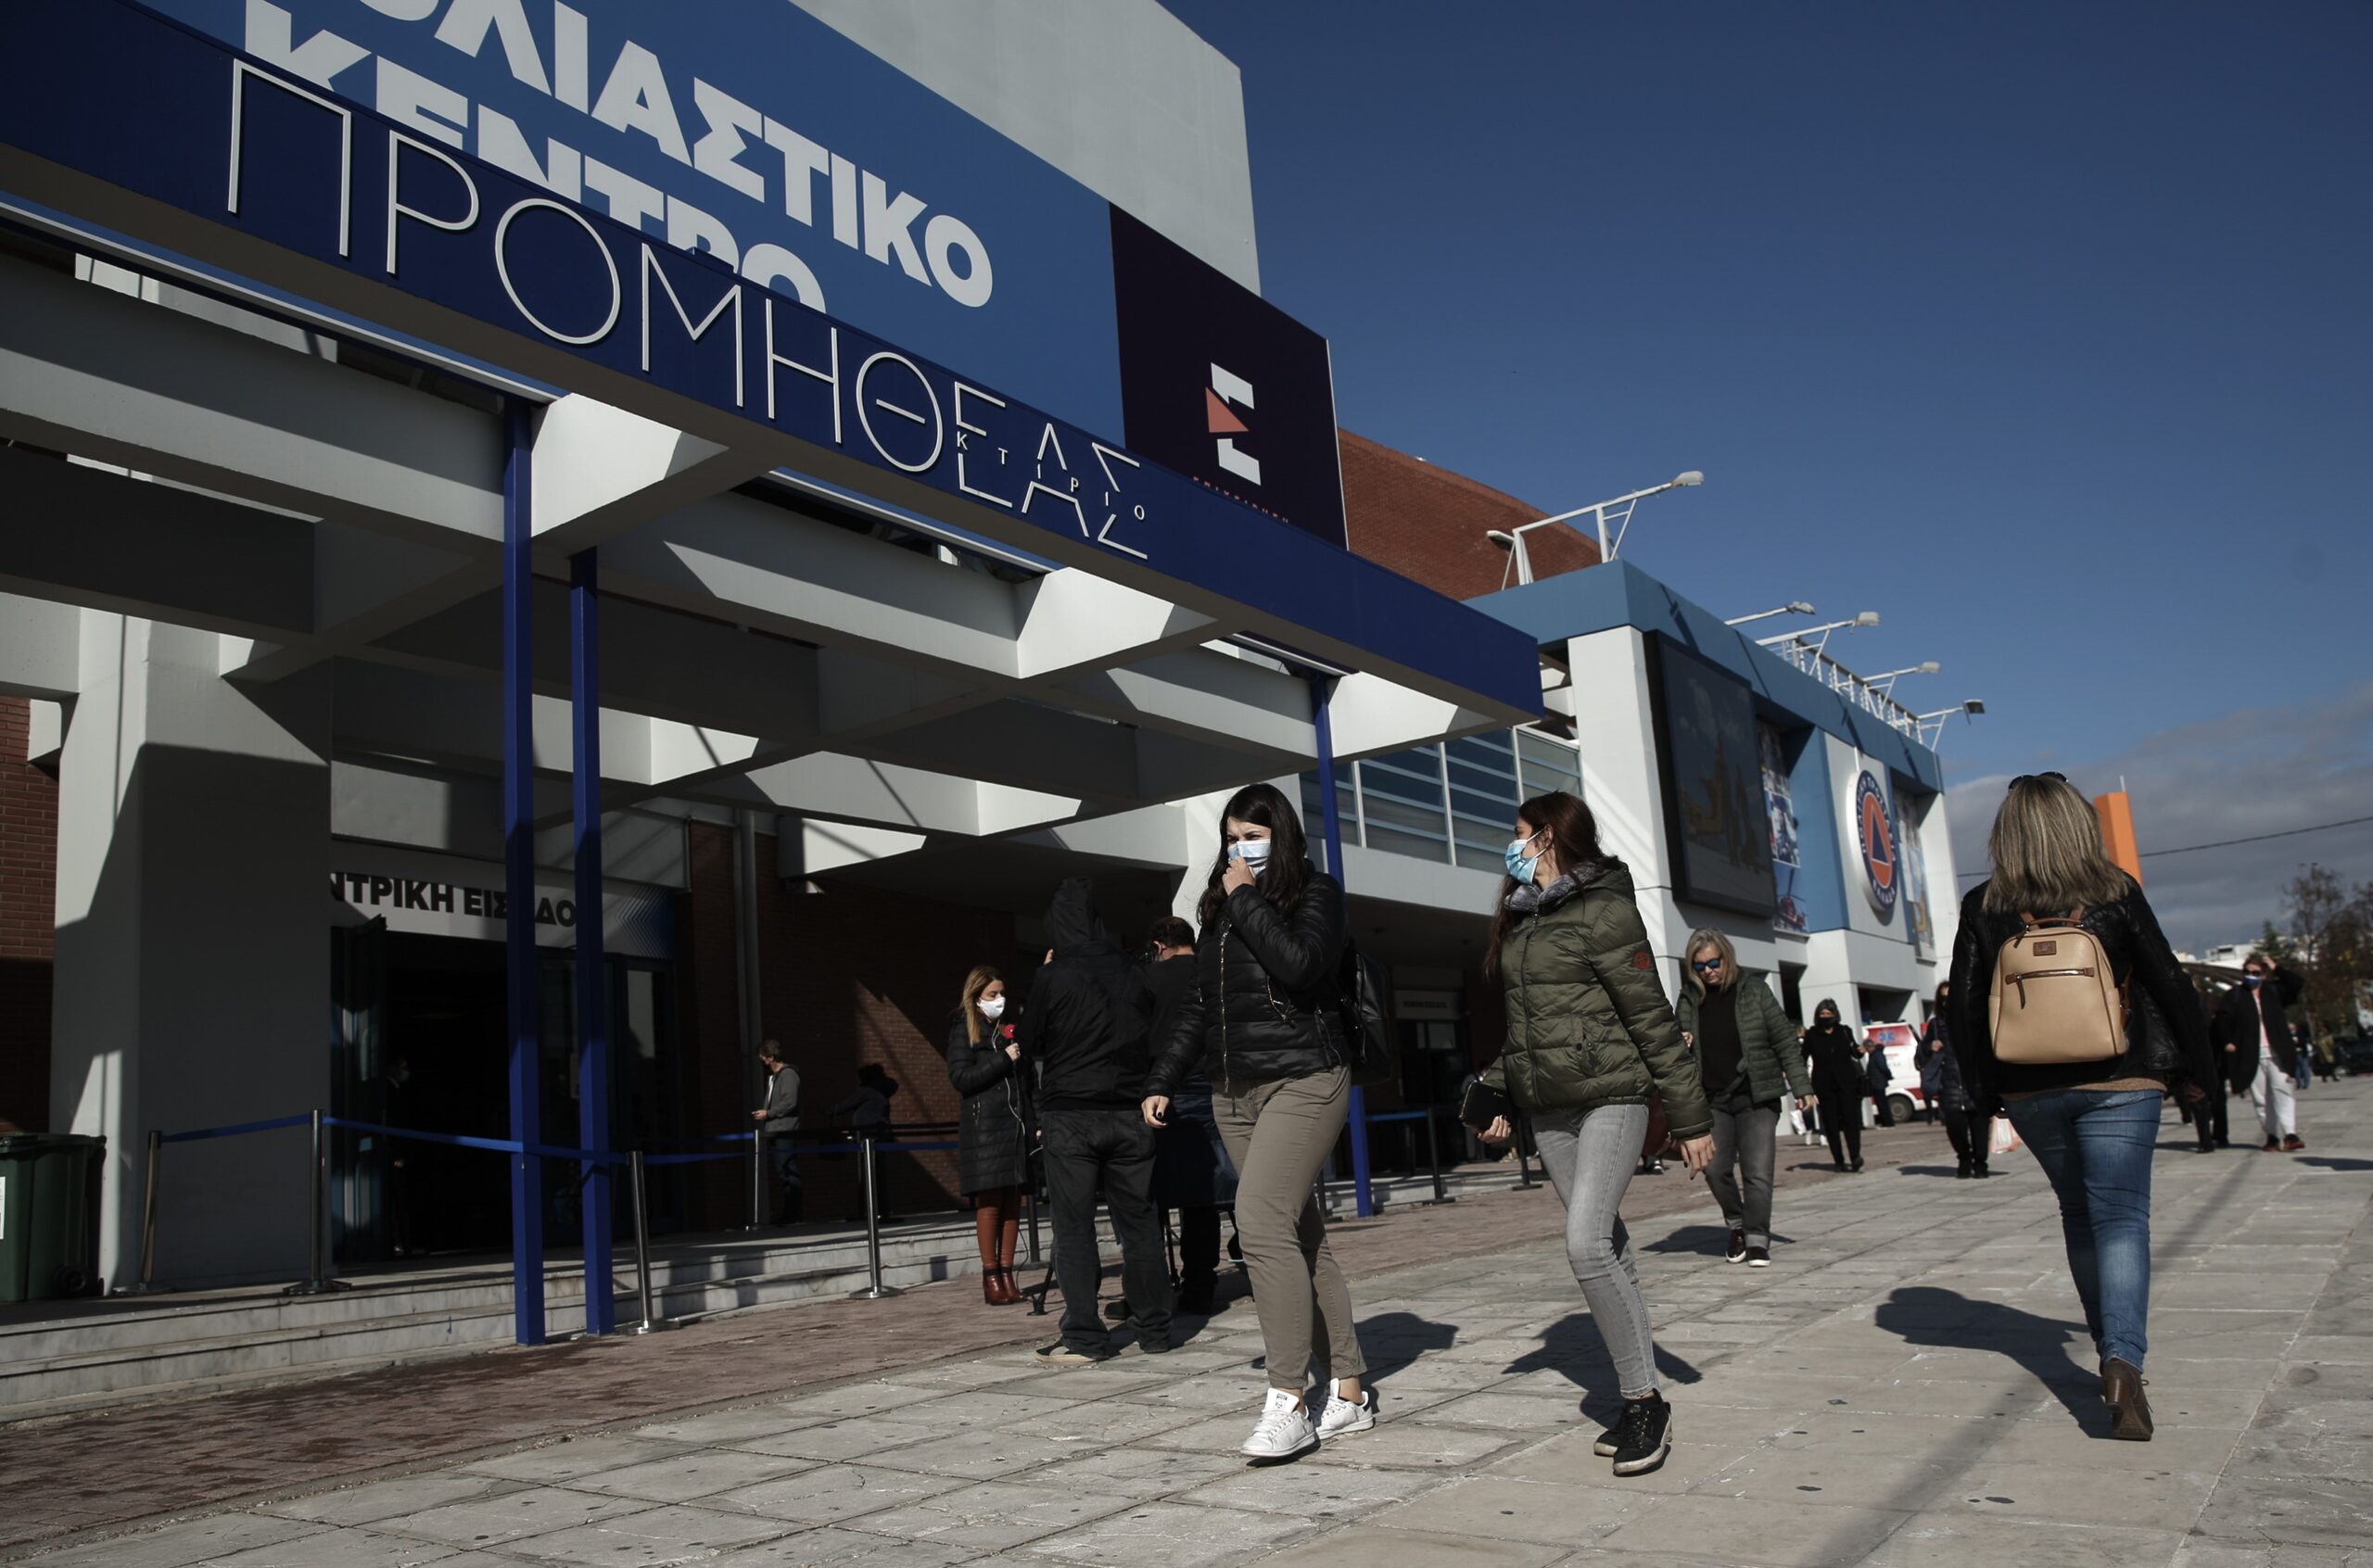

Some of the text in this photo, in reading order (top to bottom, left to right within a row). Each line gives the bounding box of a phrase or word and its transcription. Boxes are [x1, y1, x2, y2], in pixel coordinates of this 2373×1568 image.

[359, 0, 993, 308] ΛΙΑΣΤΙΚΟ
[228, 57, 1148, 562] ΠΡΟΜΗΘΕΑΣ
[956, 430, 1147, 521] ΚΤΙΡΙΟ
[329, 871, 577, 928] ΝΤΡΙΚΗ ΕΙΣΔΟ
